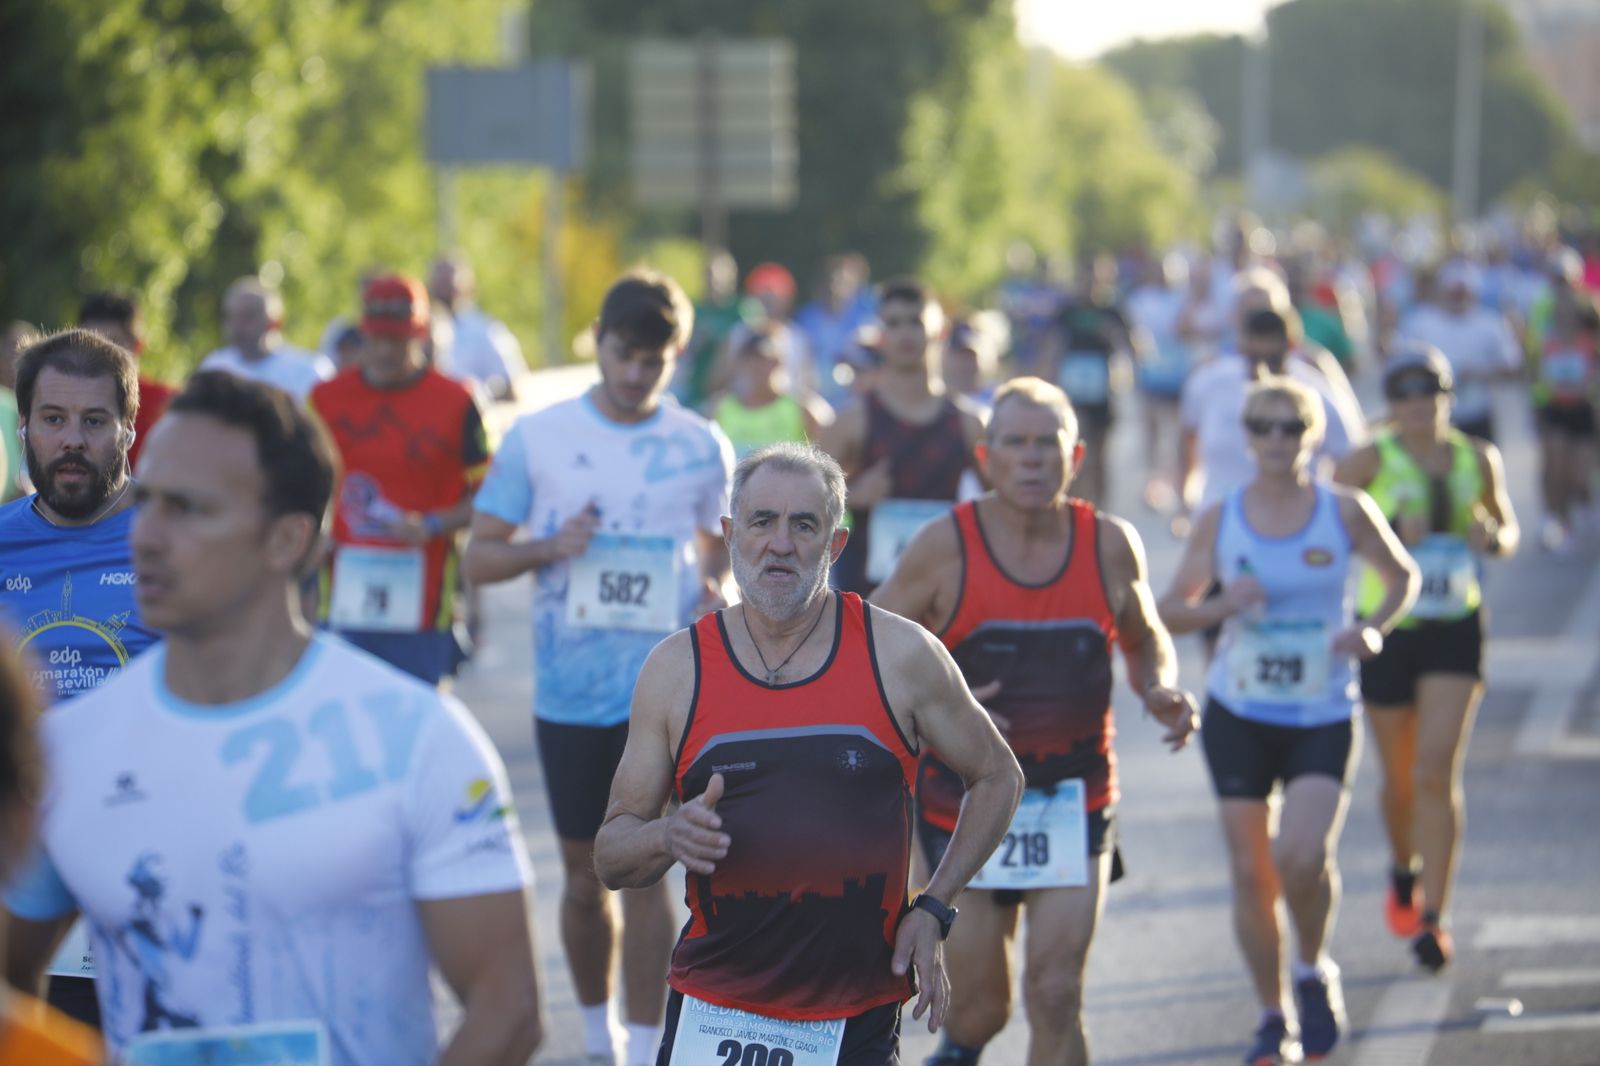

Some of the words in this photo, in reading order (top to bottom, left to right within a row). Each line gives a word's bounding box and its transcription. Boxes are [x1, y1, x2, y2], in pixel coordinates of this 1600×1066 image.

[6, 574, 33, 594] edp
[99, 572, 139, 586] HOK
[598, 570, 651, 607] 582
[49, 646, 82, 668] edp
[41, 666, 105, 682] maratón
[57, 675, 105, 690] sevilla
[691, 1000, 746, 1018] MEDIA
[699, 1024, 732, 1038] FRANCISCO
[734, 1029, 757, 1041] JAVIER
[795, 1042, 818, 1055] GRACIA
[800, 1031, 815, 1042] DEL
